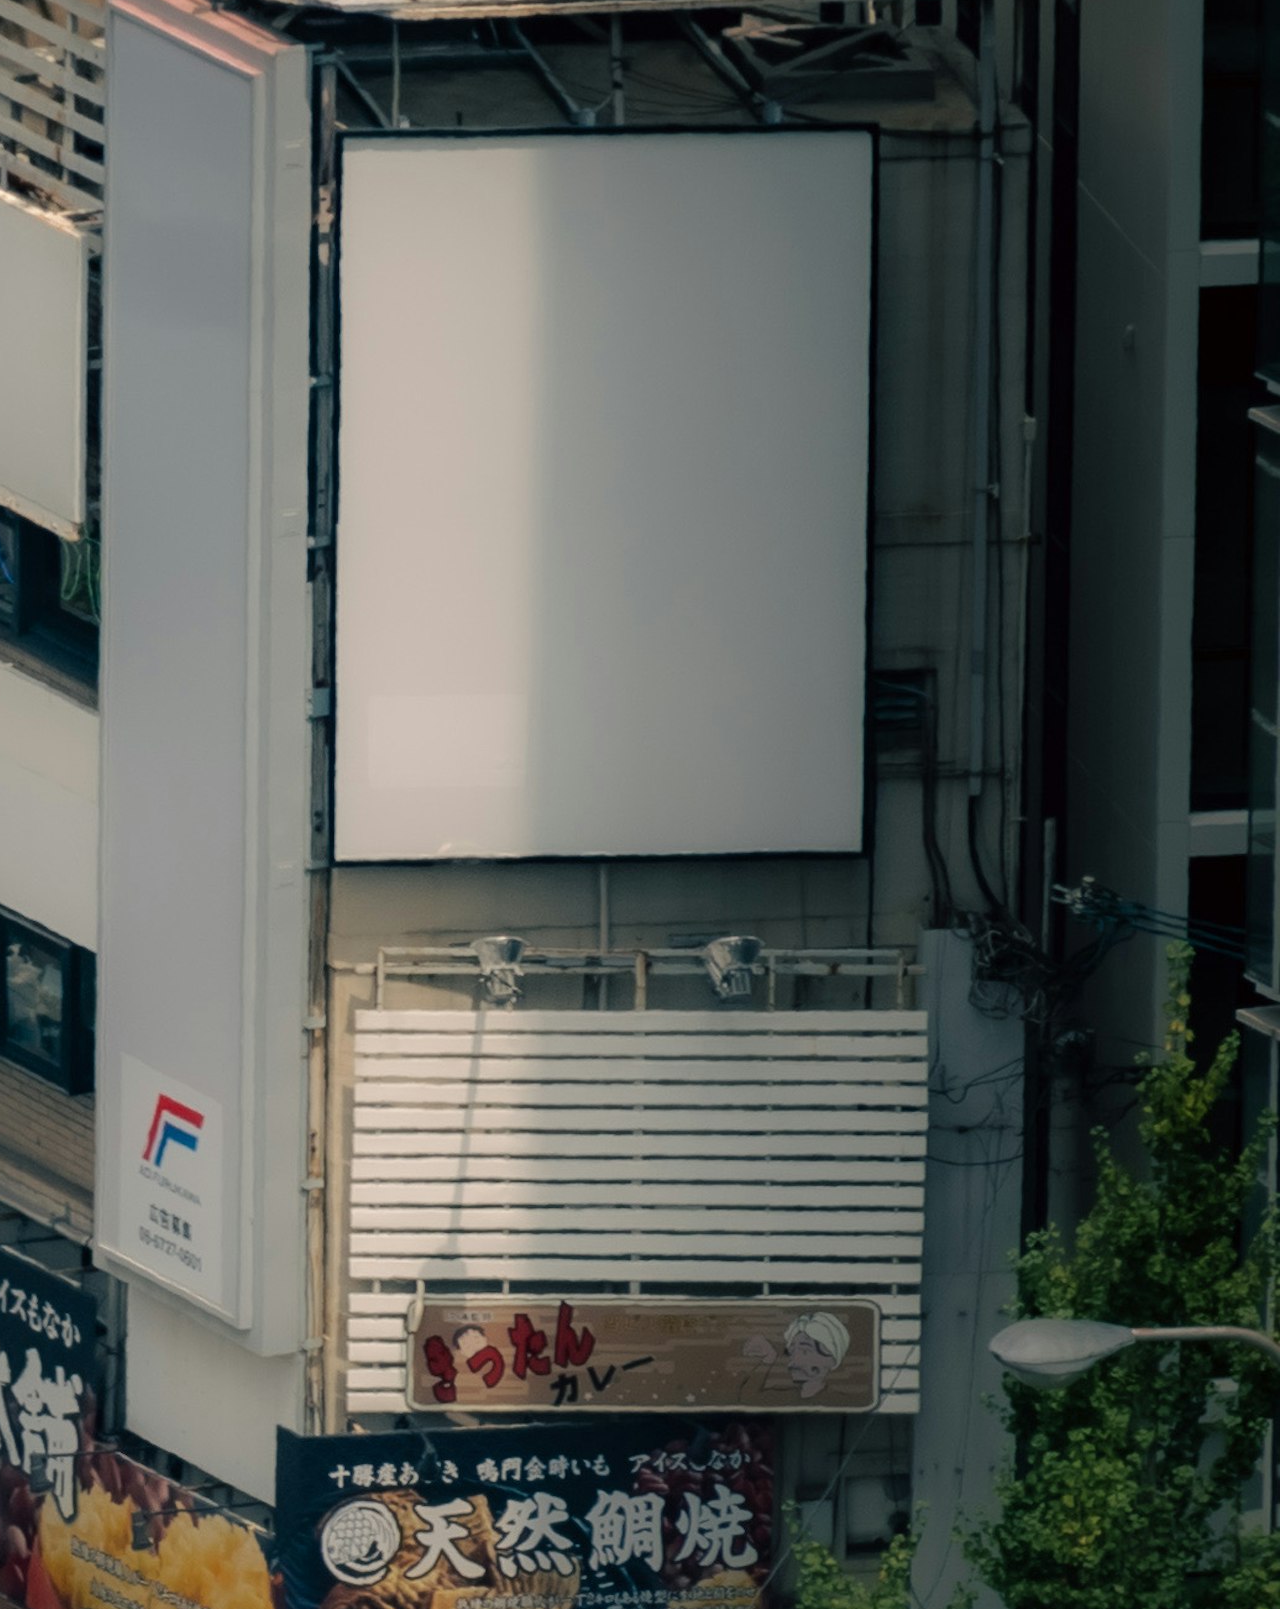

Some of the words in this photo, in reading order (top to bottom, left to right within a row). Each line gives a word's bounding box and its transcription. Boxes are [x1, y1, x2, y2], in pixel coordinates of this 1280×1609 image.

[549, 1356, 654, 1406] カレー
[328, 1458, 460, 1489] 十勝産あき
[475, 1454, 612, 1485] 鳴門金時いも
[404, 1484, 759, 1582] 天然鯛焼
